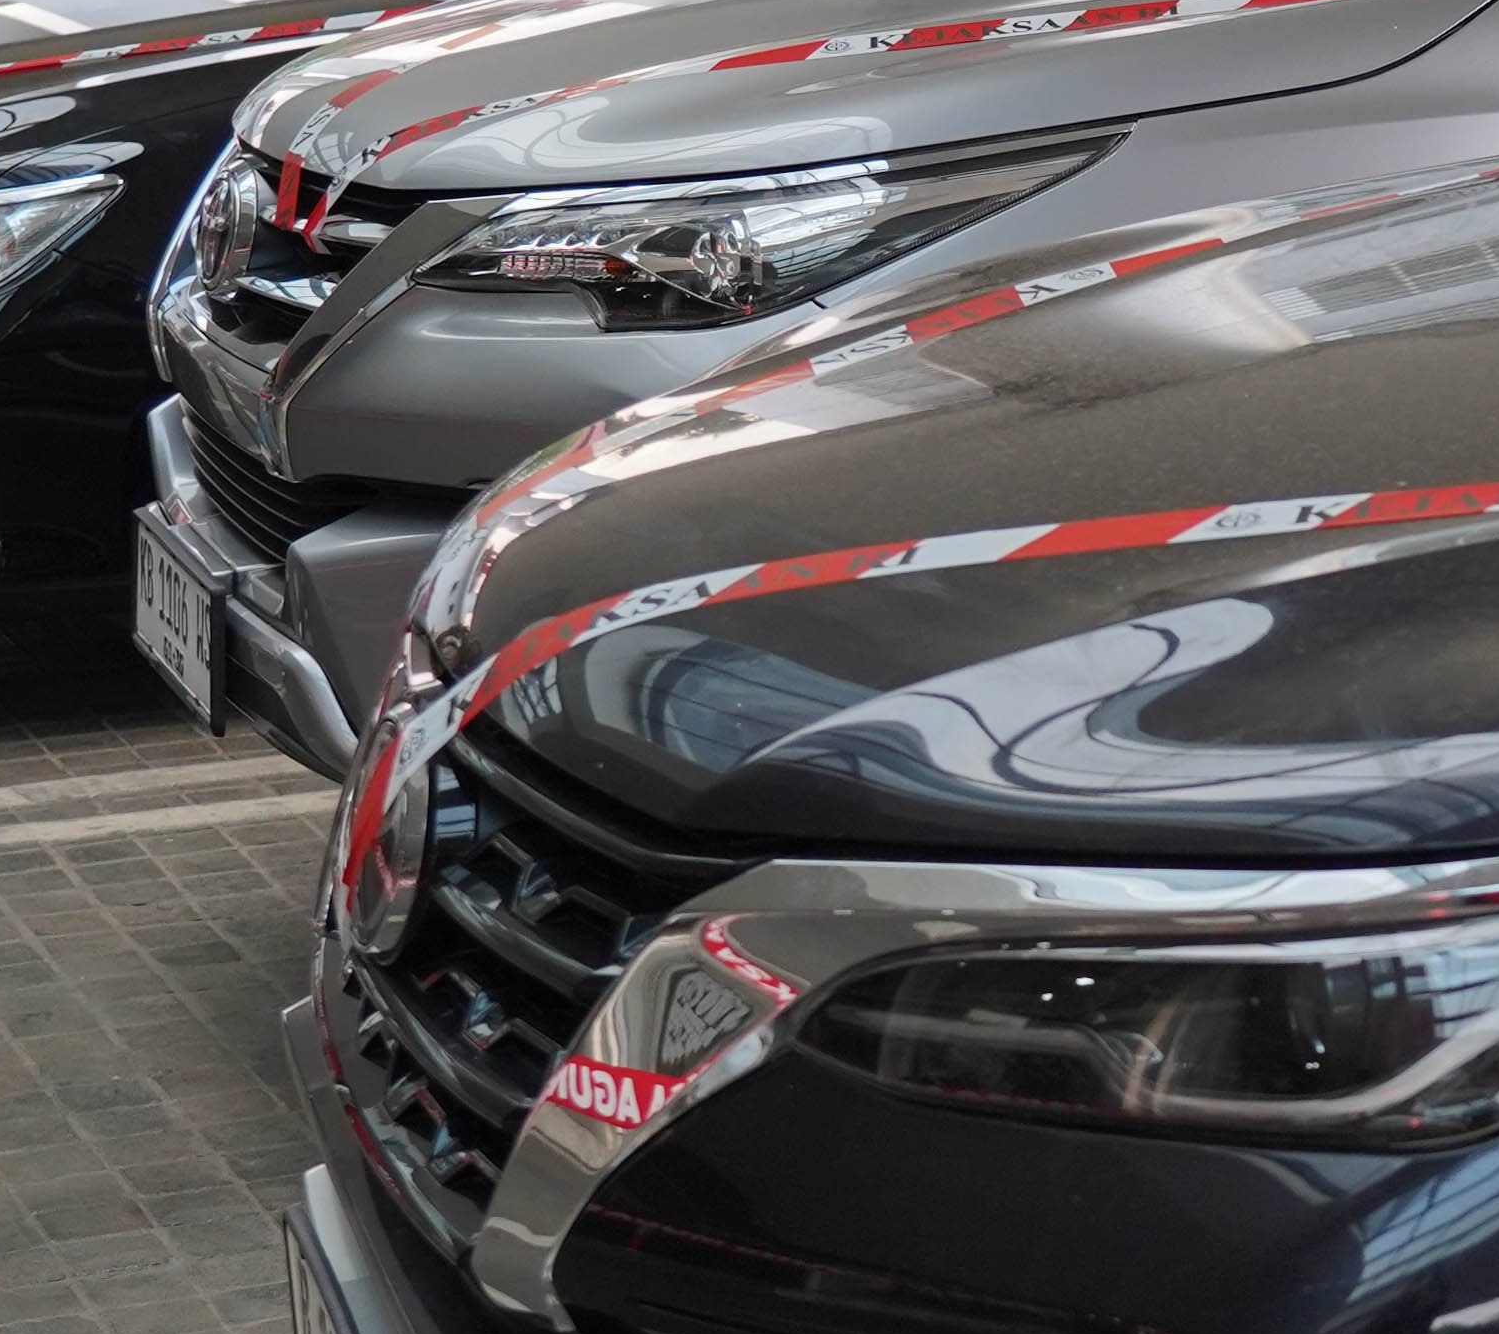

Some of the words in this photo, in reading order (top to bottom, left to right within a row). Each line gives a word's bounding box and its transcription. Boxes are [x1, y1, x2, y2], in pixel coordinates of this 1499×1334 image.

[869, 9, 1123, 50] KEJAKSAAN
[139, 534, 154, 608] KB
[157, 556, 189, 647] 1106
[447, 559, 815, 730] KEJAKSAAN
